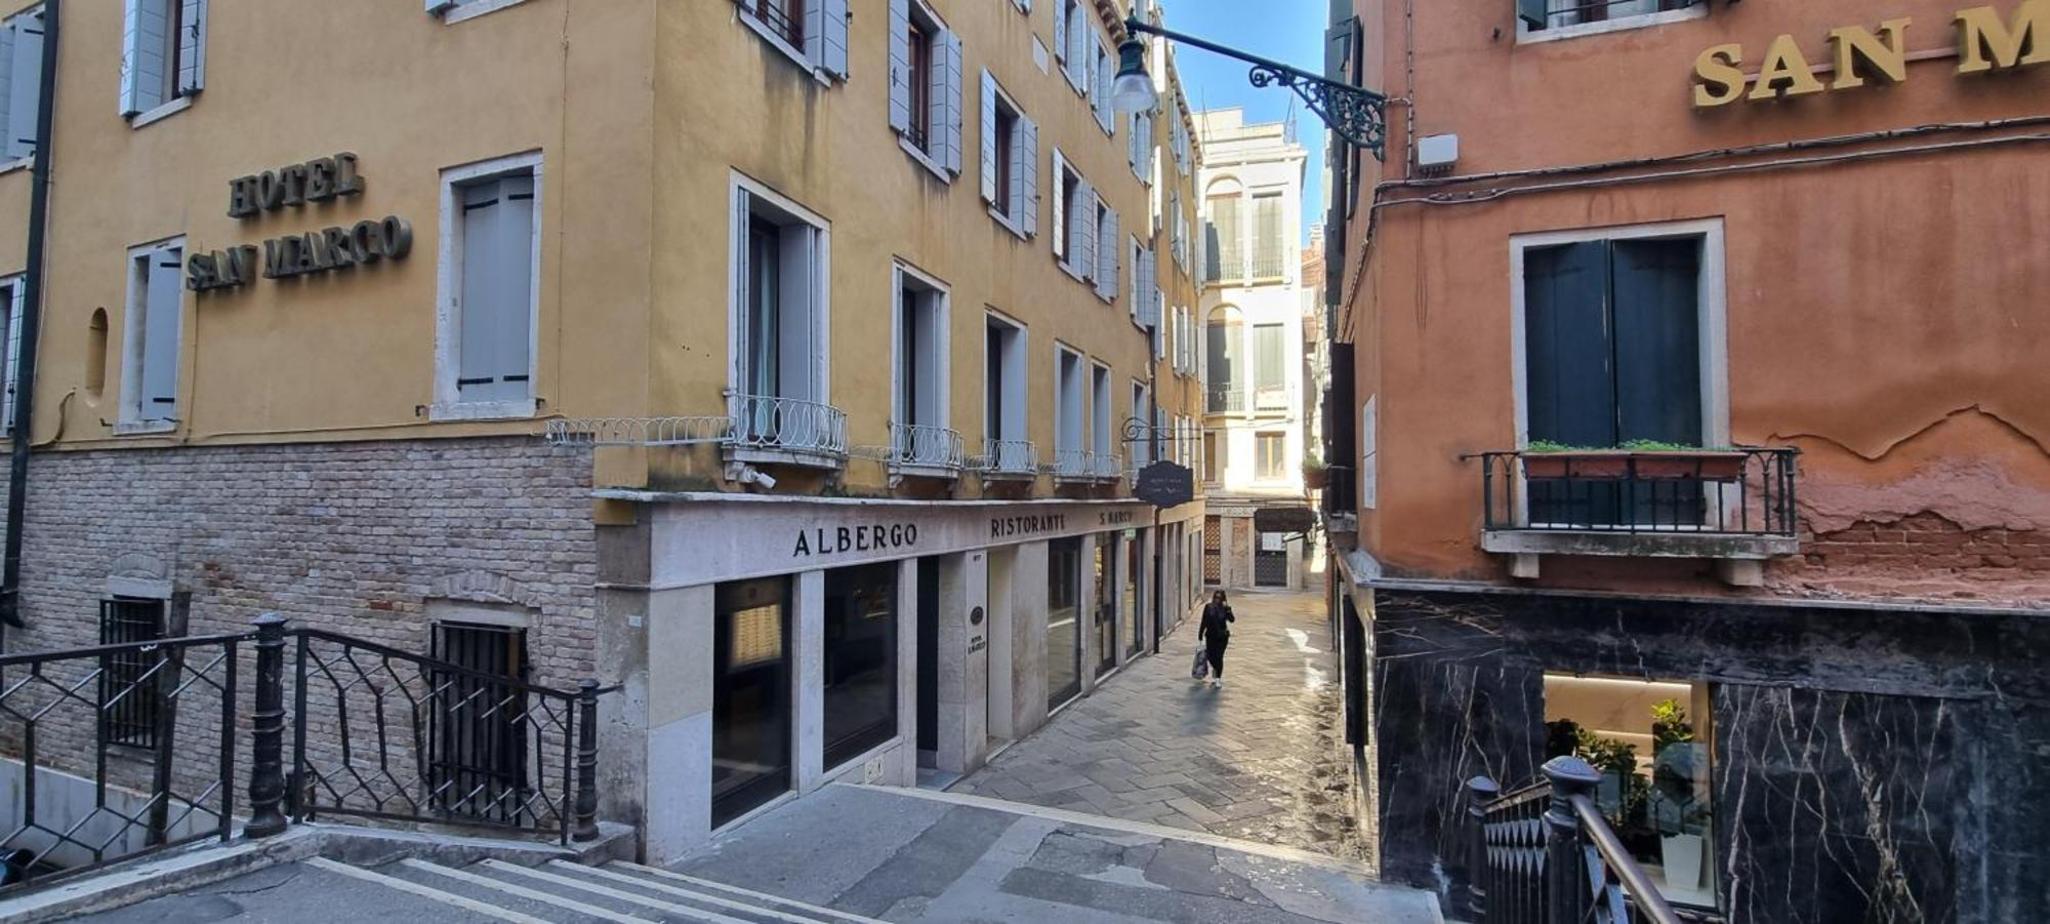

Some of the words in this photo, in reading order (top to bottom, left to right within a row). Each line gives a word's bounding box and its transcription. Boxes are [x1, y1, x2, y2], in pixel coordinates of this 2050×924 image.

[1693, 16, 1911, 107] SAN
[228, 151, 365, 218] HOTEL
[187, 245, 257, 291] SAN
[263, 215, 413, 279] MARCO
[793, 523, 917, 557] ALBERGO
[991, 514, 1064, 538] RISTORANTE
